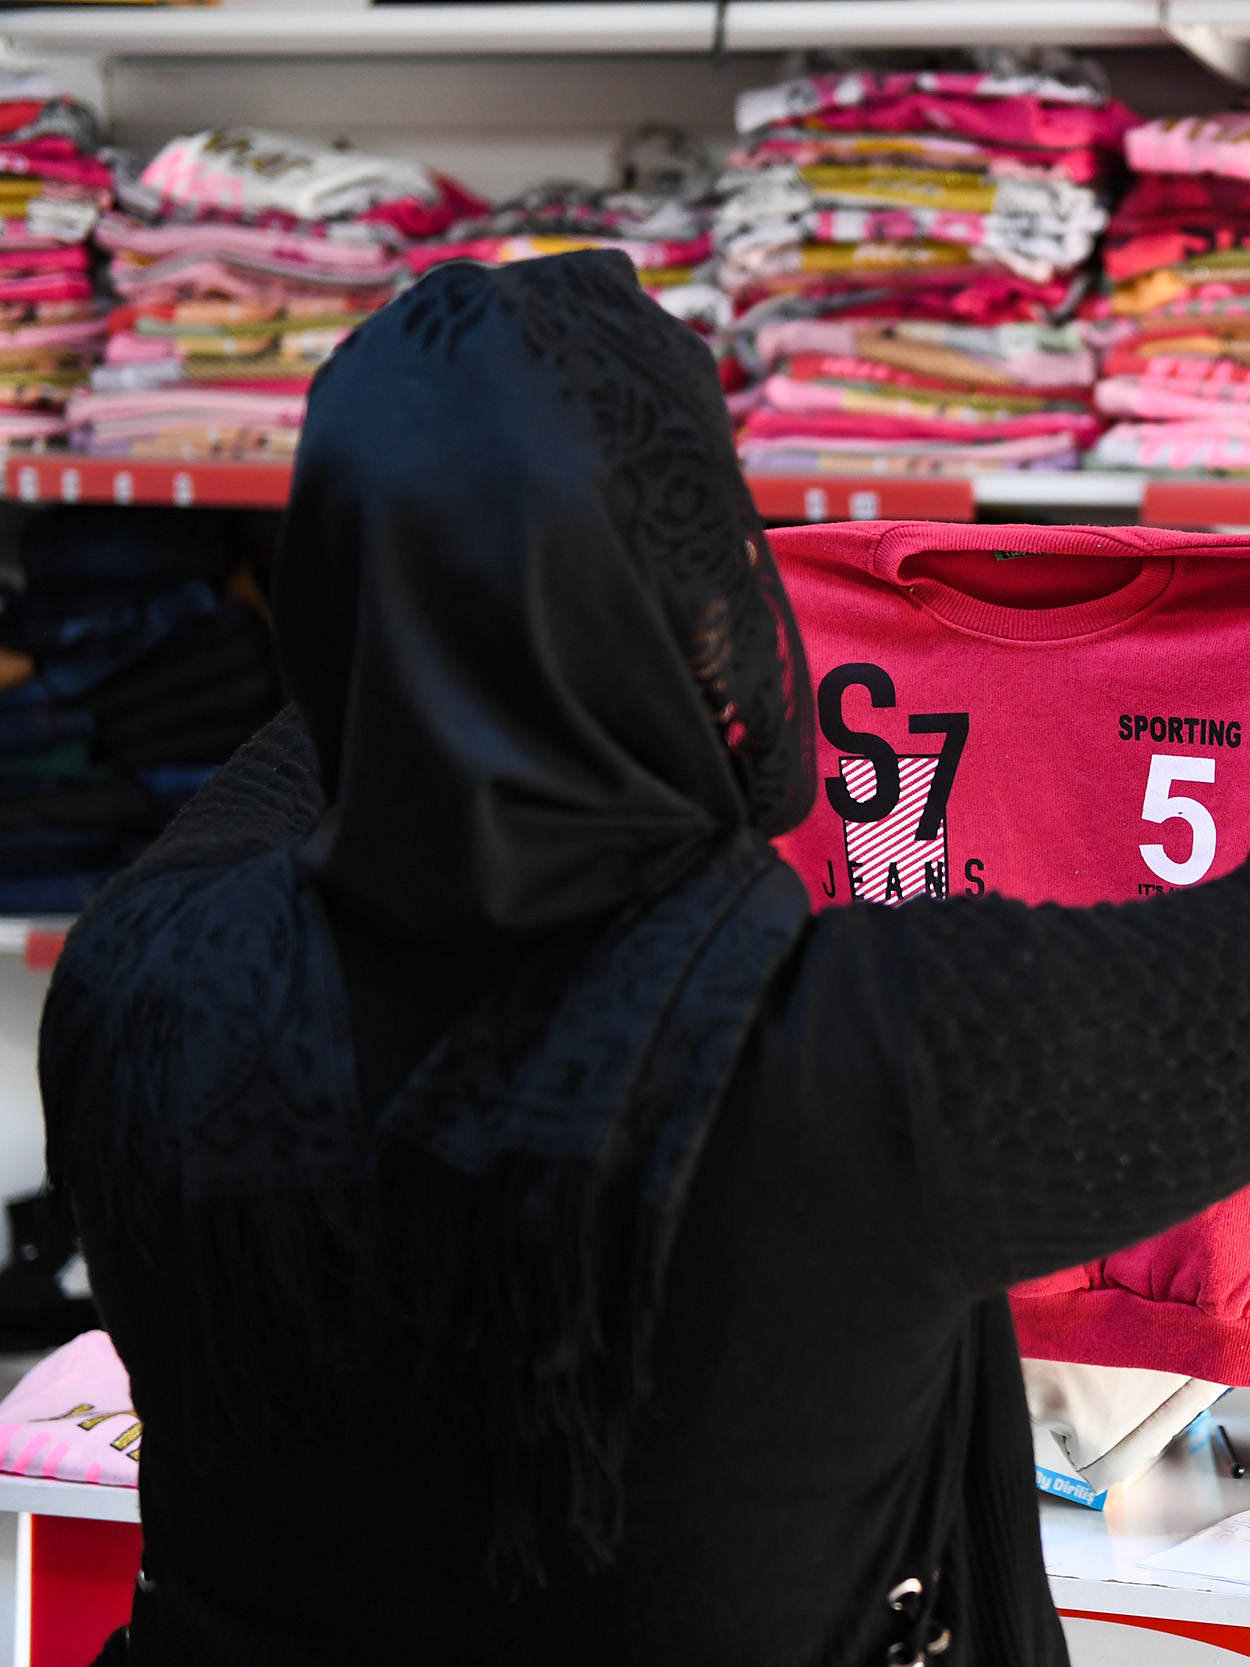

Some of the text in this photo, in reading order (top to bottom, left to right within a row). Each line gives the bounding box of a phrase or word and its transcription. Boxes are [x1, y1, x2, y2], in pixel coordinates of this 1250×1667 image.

[818, 662, 970, 841] S7
[1118, 714, 1242, 748] SPORTING
[1138, 754, 1217, 886] 5
[822, 858, 985, 900] JEANS
[1138, 883, 1164, 896] IT'S
